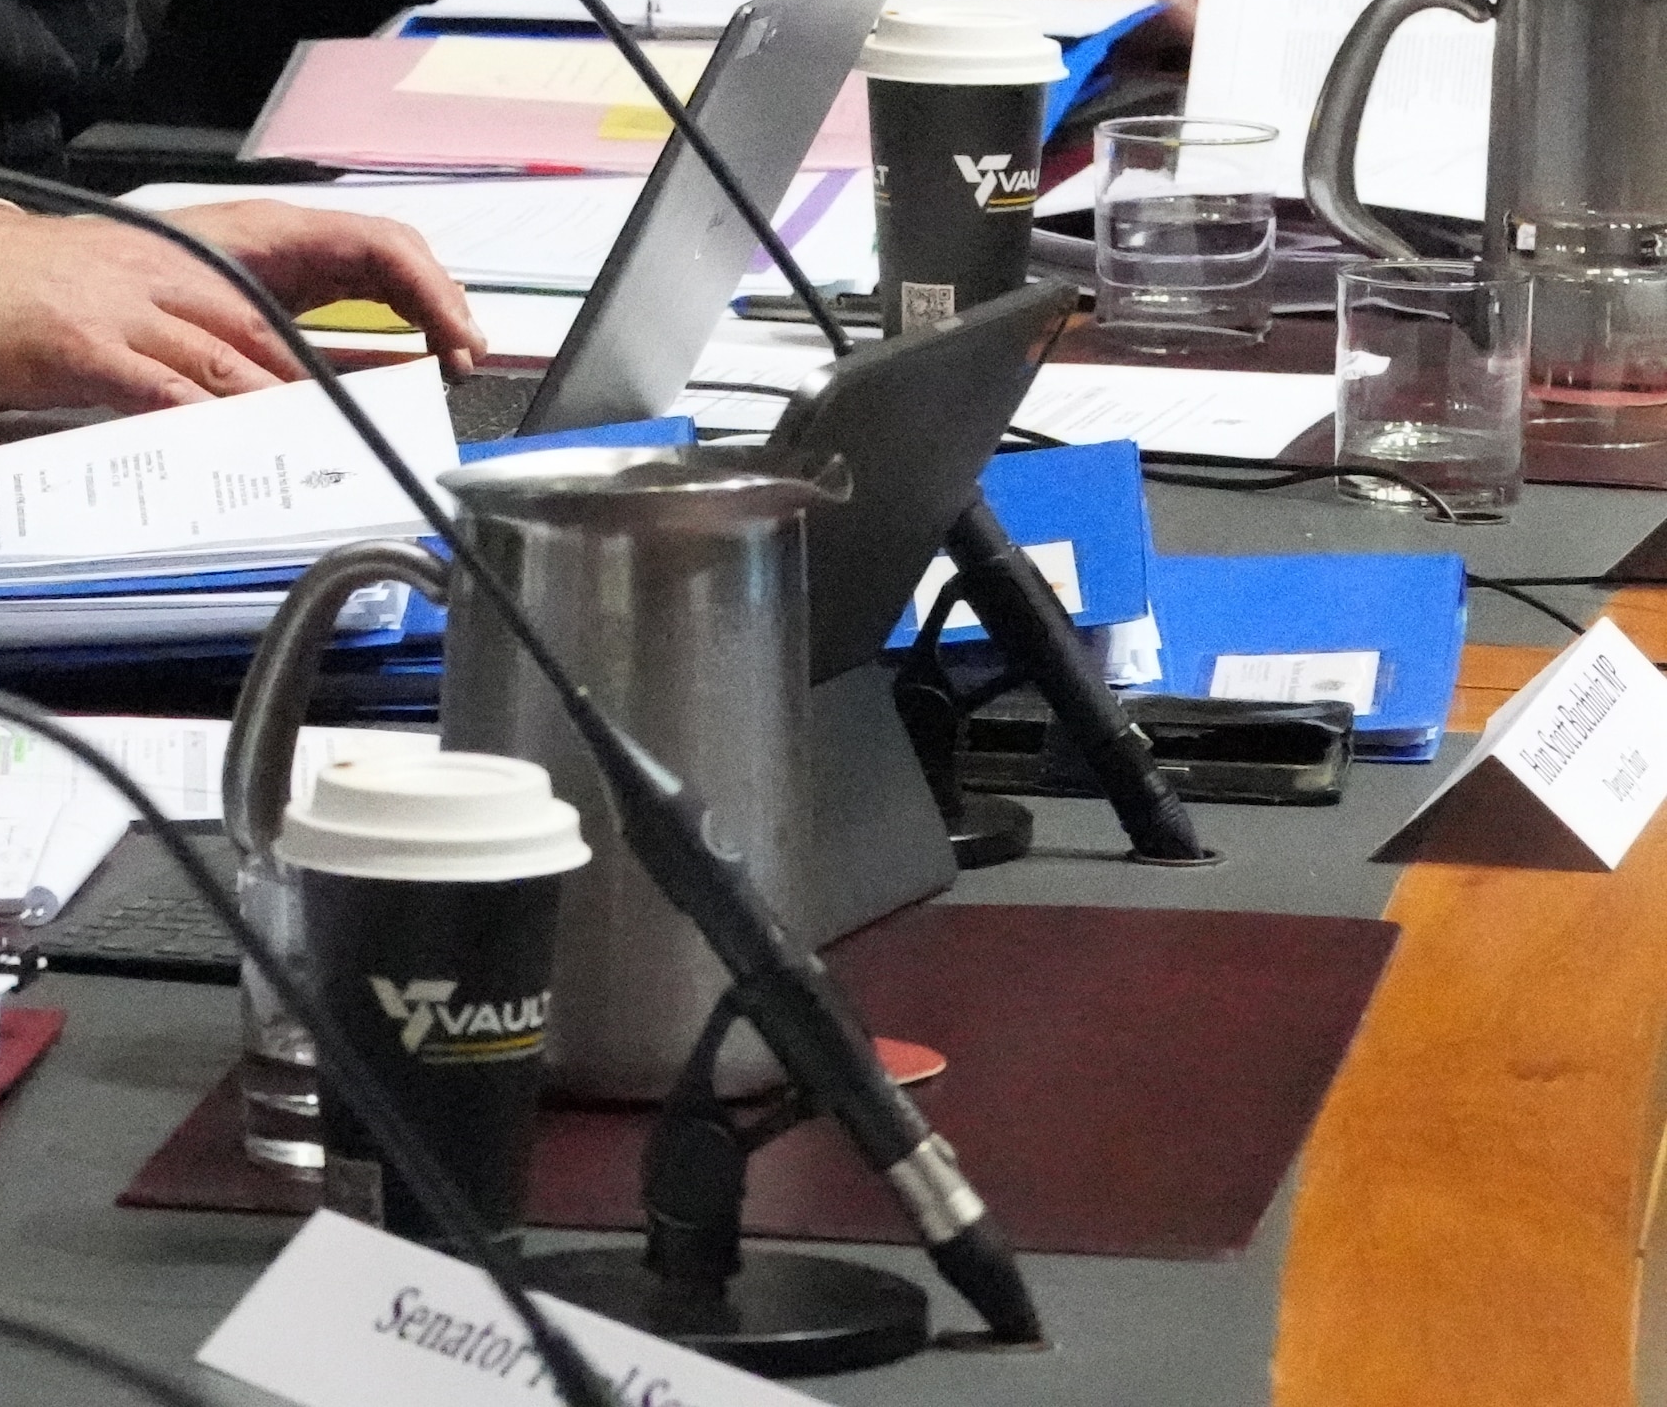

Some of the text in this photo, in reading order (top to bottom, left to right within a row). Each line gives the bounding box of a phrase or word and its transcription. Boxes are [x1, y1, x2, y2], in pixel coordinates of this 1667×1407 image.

[1519, 654, 1627, 786] Hon Scott Buchholz MP
[1602, 746, 1650, 802] Deputy Chair
[375, 1286, 536, 1378] Senator
